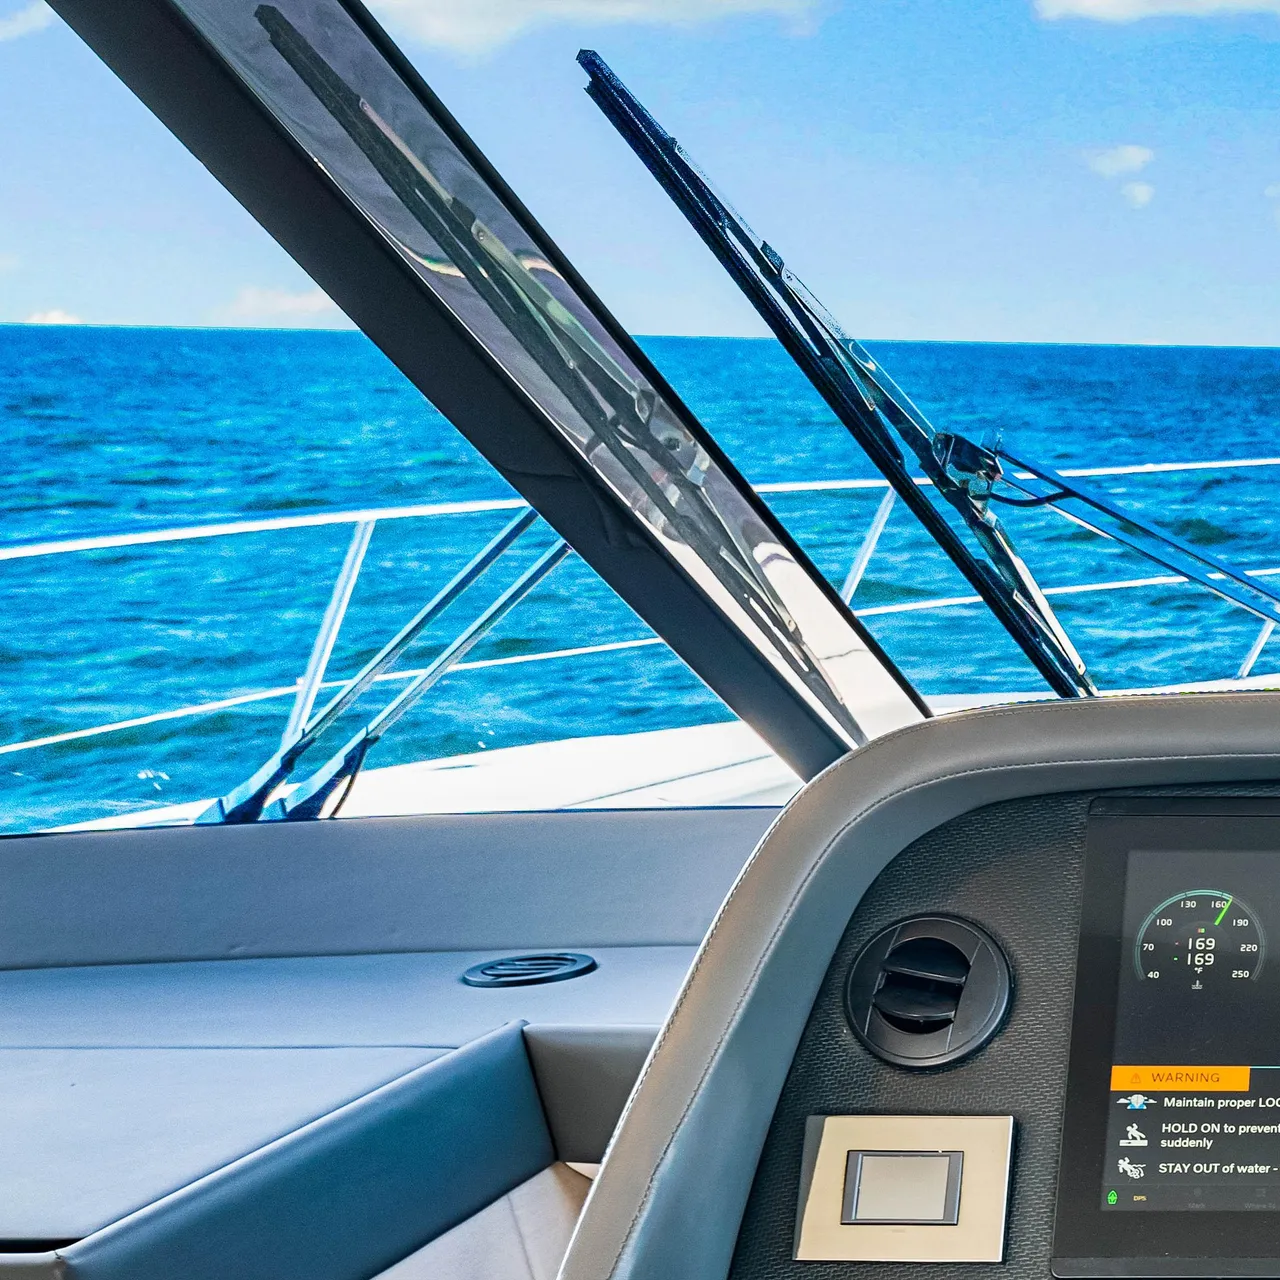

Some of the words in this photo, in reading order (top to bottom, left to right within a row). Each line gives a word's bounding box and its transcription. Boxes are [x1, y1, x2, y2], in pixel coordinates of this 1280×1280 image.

[1156, 918, 1172, 926] 100
[1188, 938, 1215, 949] 169
[1187, 953, 1214, 965] 169
[1152, 1072, 1220, 1083] WARNING
[1164, 1098, 1215, 1108] Maintain
[1218, 1099, 1255, 1110] proper
[1162, 1123, 1197, 1133] HOLD
[1201, 1123, 1220, 1133] ON
[1224, 1125, 1235, 1133] to
[1161, 1138, 1213, 1149] suddenly
[1159, 1164, 1190, 1174] STAY
[1193, 1164, 1220, 1174] OUT
[1222, 1163, 1235, 1174] of
[1237, 1164, 1270, 1174] water
